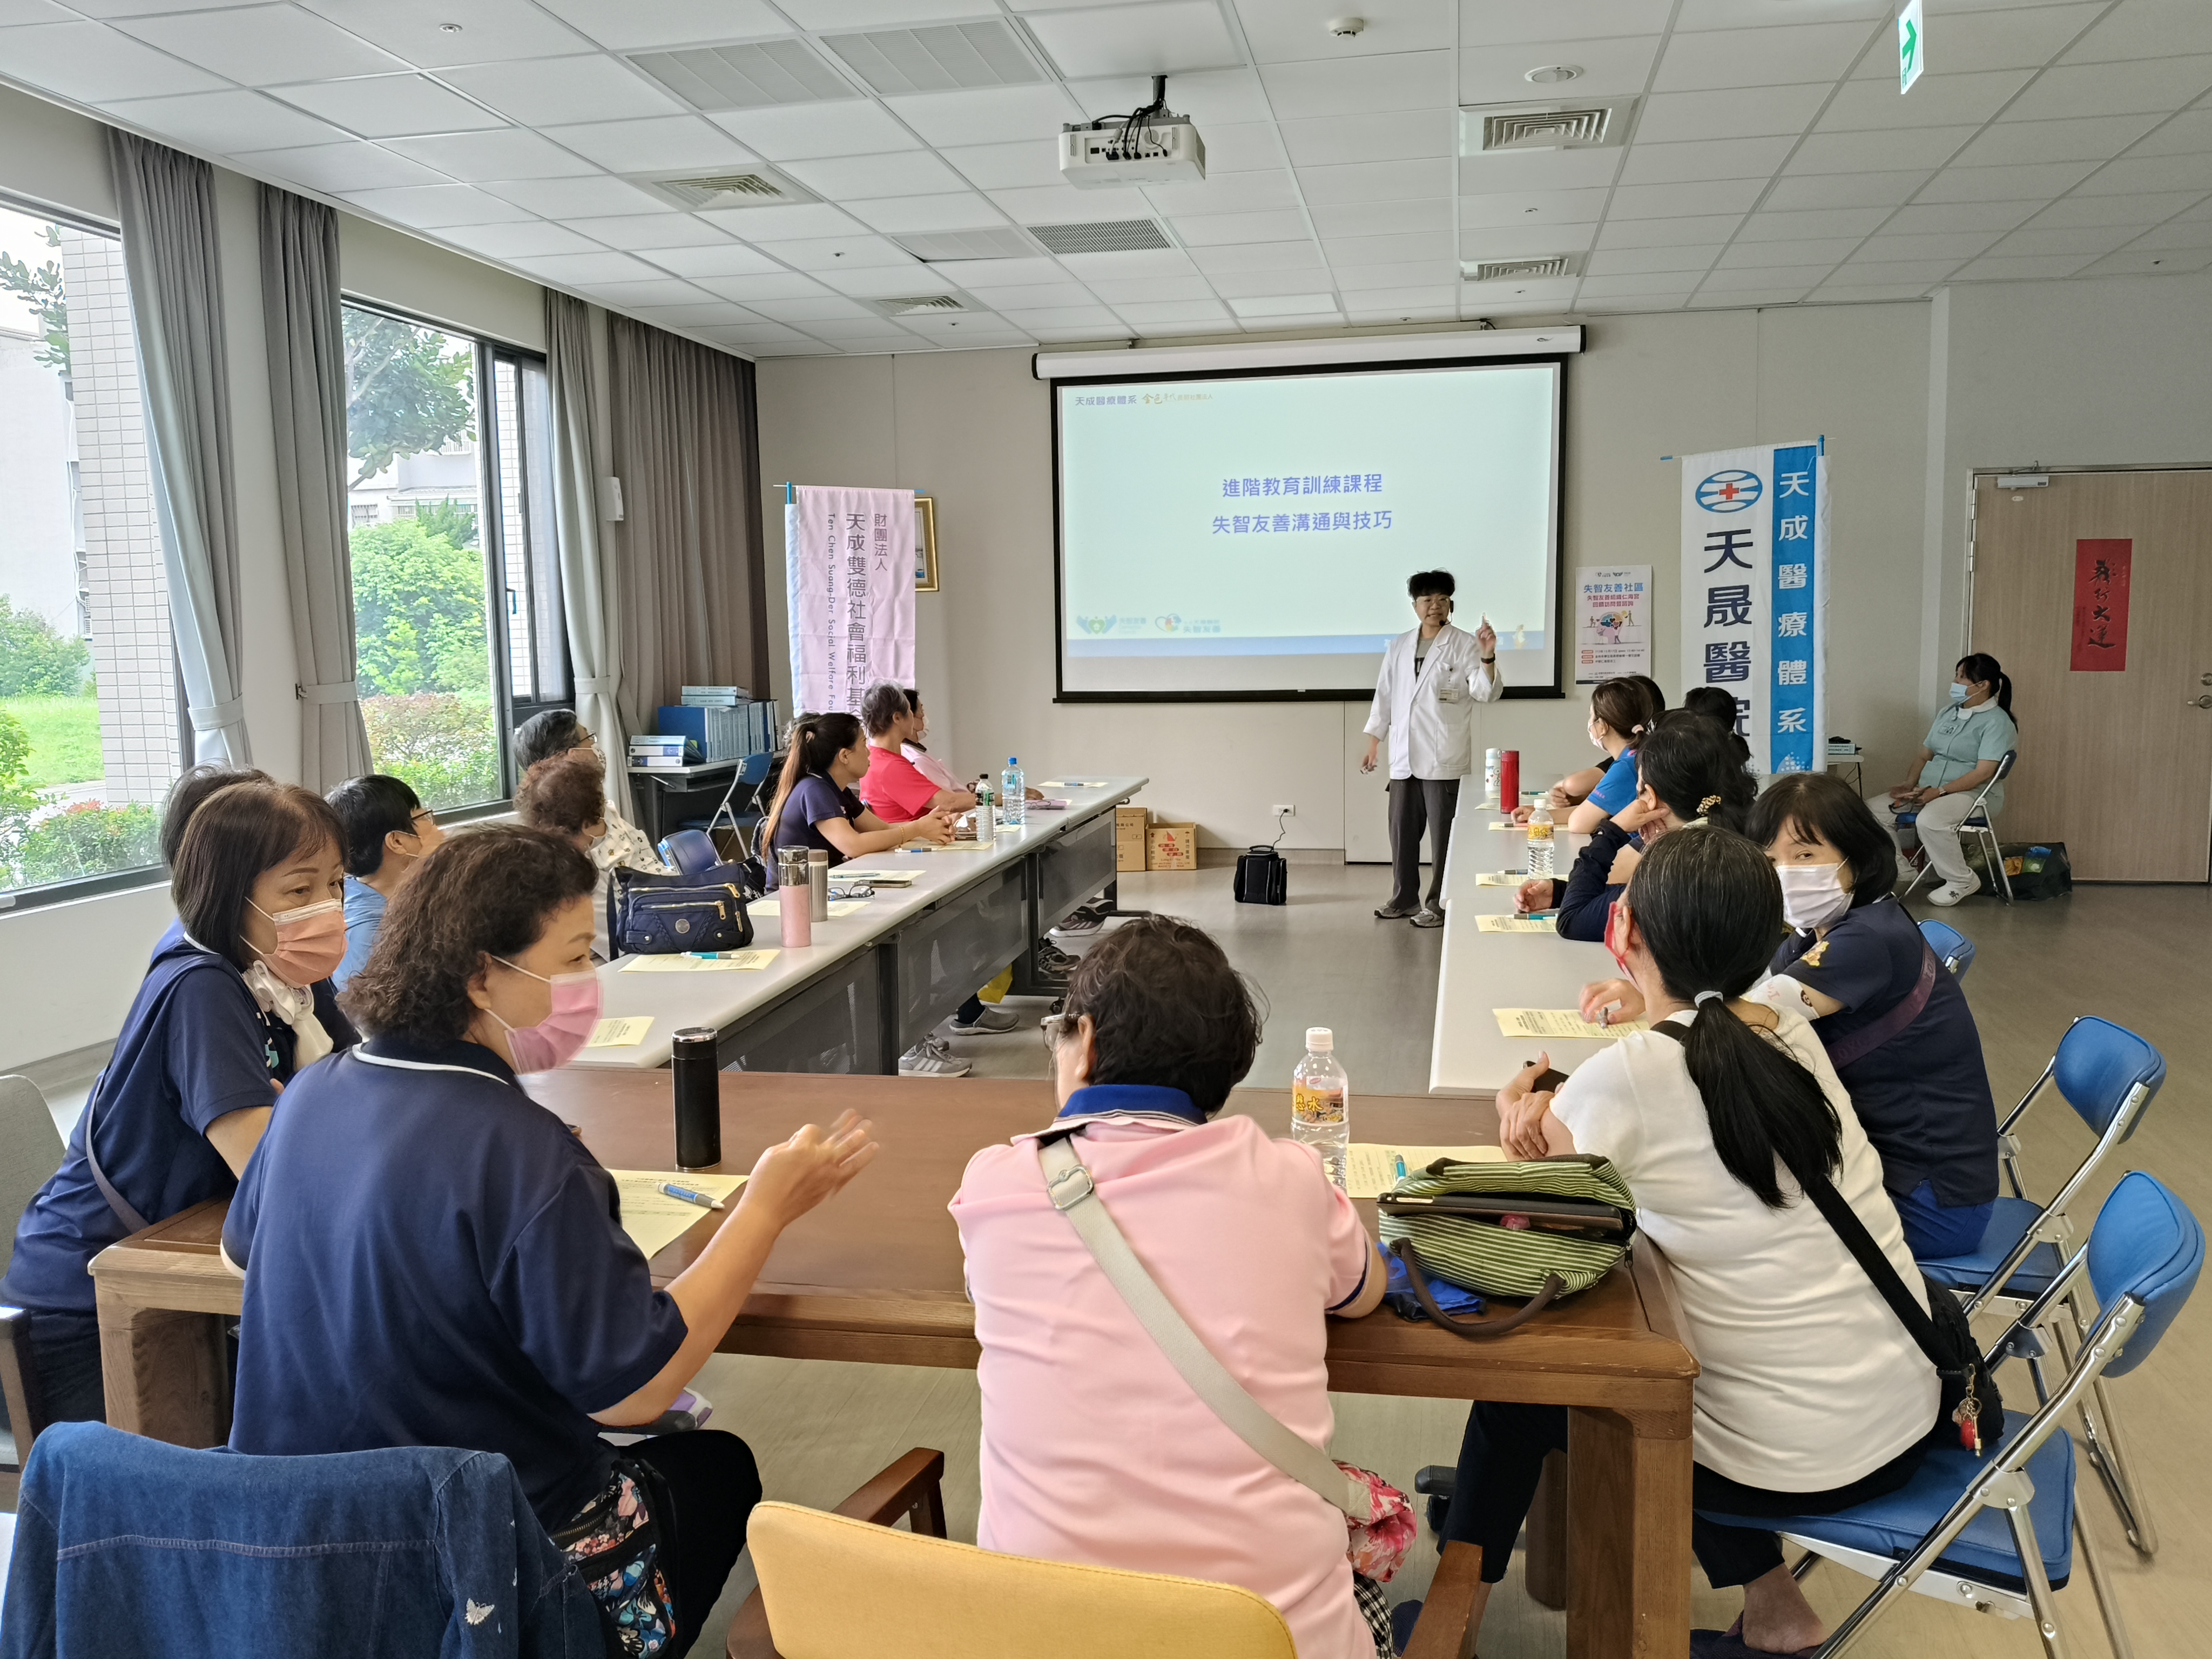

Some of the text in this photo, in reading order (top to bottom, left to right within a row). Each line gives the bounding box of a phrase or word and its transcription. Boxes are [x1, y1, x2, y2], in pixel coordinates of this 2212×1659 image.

[1075, 395, 1137, 406] 天成醫療體系
[1223, 474, 1382, 497] 進階教育訓練課程
[827, 513, 835, 531] Ten
[1212, 510, 1392, 534] 失智友善溝通與技巧
[828, 535, 836, 559] Chen
[874, 514, 888, 571] 財團法人
[827, 564, 836, 614] Suang-Der
[1583, 583, 1643, 593] 失智友善社區
[1778, 471, 1809, 733] 天成醫療體系
[846, 513, 867, 717] 天成雙德社會福利基
[828, 619, 836, 647] Social
[827, 651, 837, 690] Welfare
[1292, 1094, 1324, 1112] 悲水
